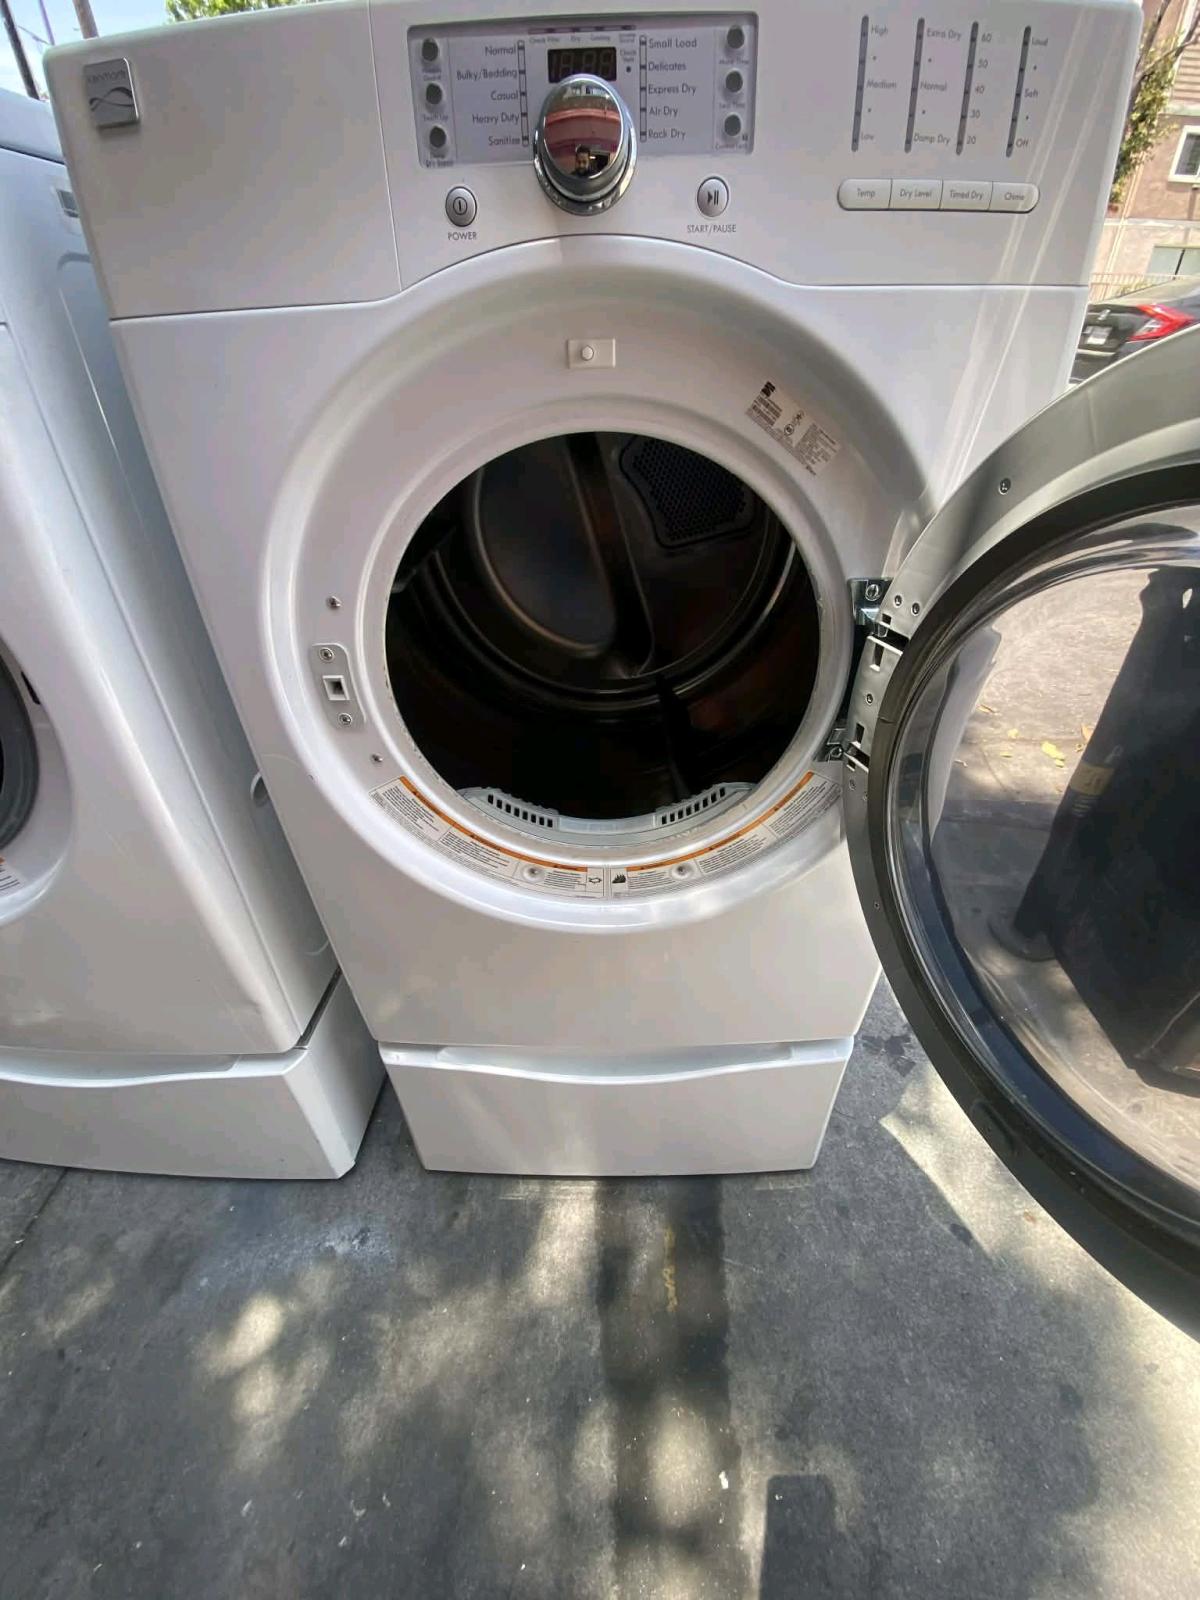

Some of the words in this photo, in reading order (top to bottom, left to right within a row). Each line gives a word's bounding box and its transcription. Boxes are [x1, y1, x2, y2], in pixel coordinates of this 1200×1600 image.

[871, 25, 888, 36] High
[927, 28, 946, 37] Extra
[948, 29, 962, 41] Dry
[981, 33, 992, 42] 60
[1032, 38, 1048, 46] Loud
[649, 39, 672, 49] Small
[675, 38, 697, 48] Load
[485, 45, 517, 56] Normal
[648, 62, 687, 71] Delicates
[978, 59, 988, 68] 50
[456, 68, 517, 81] Bulky/Bedding
[648, 84, 679, 96] Express
[681, 83, 697, 96] Dry
[867, 80, 897, 89] Medium
[920, 82, 948, 91] Normal
[975, 86, 985, 94] 40
[490, 90, 519, 101] Casual
[649, 107, 661, 116] Air
[663, 106, 678, 117] Dry
[970, 110, 981, 118] 30
[472, 114, 499, 125] Heavy
[501, 112, 520, 125] Duty
[648, 129, 667, 139] Rack
[670, 128, 686, 140] Dry
[861, 133, 875, 141] Low
[914, 134, 935, 144] Damp
[937, 133, 950, 145] Dry
[488, 136, 521, 146] Sanitize
[966, 136, 976, 145] 20
[1016, 138, 1029, 148] Off
[857, 189, 876, 199] Temp
[900, 189, 912, 199] Dry
[914, 189, 933, 198] Level
[950, 190, 969, 199] Timed
[971, 191, 983, 200] Dry
[1004, 192, 1025, 201] Chime
[687, 224, 737, 233] START/PAUSE
[448, 231, 477, 240] POWER
